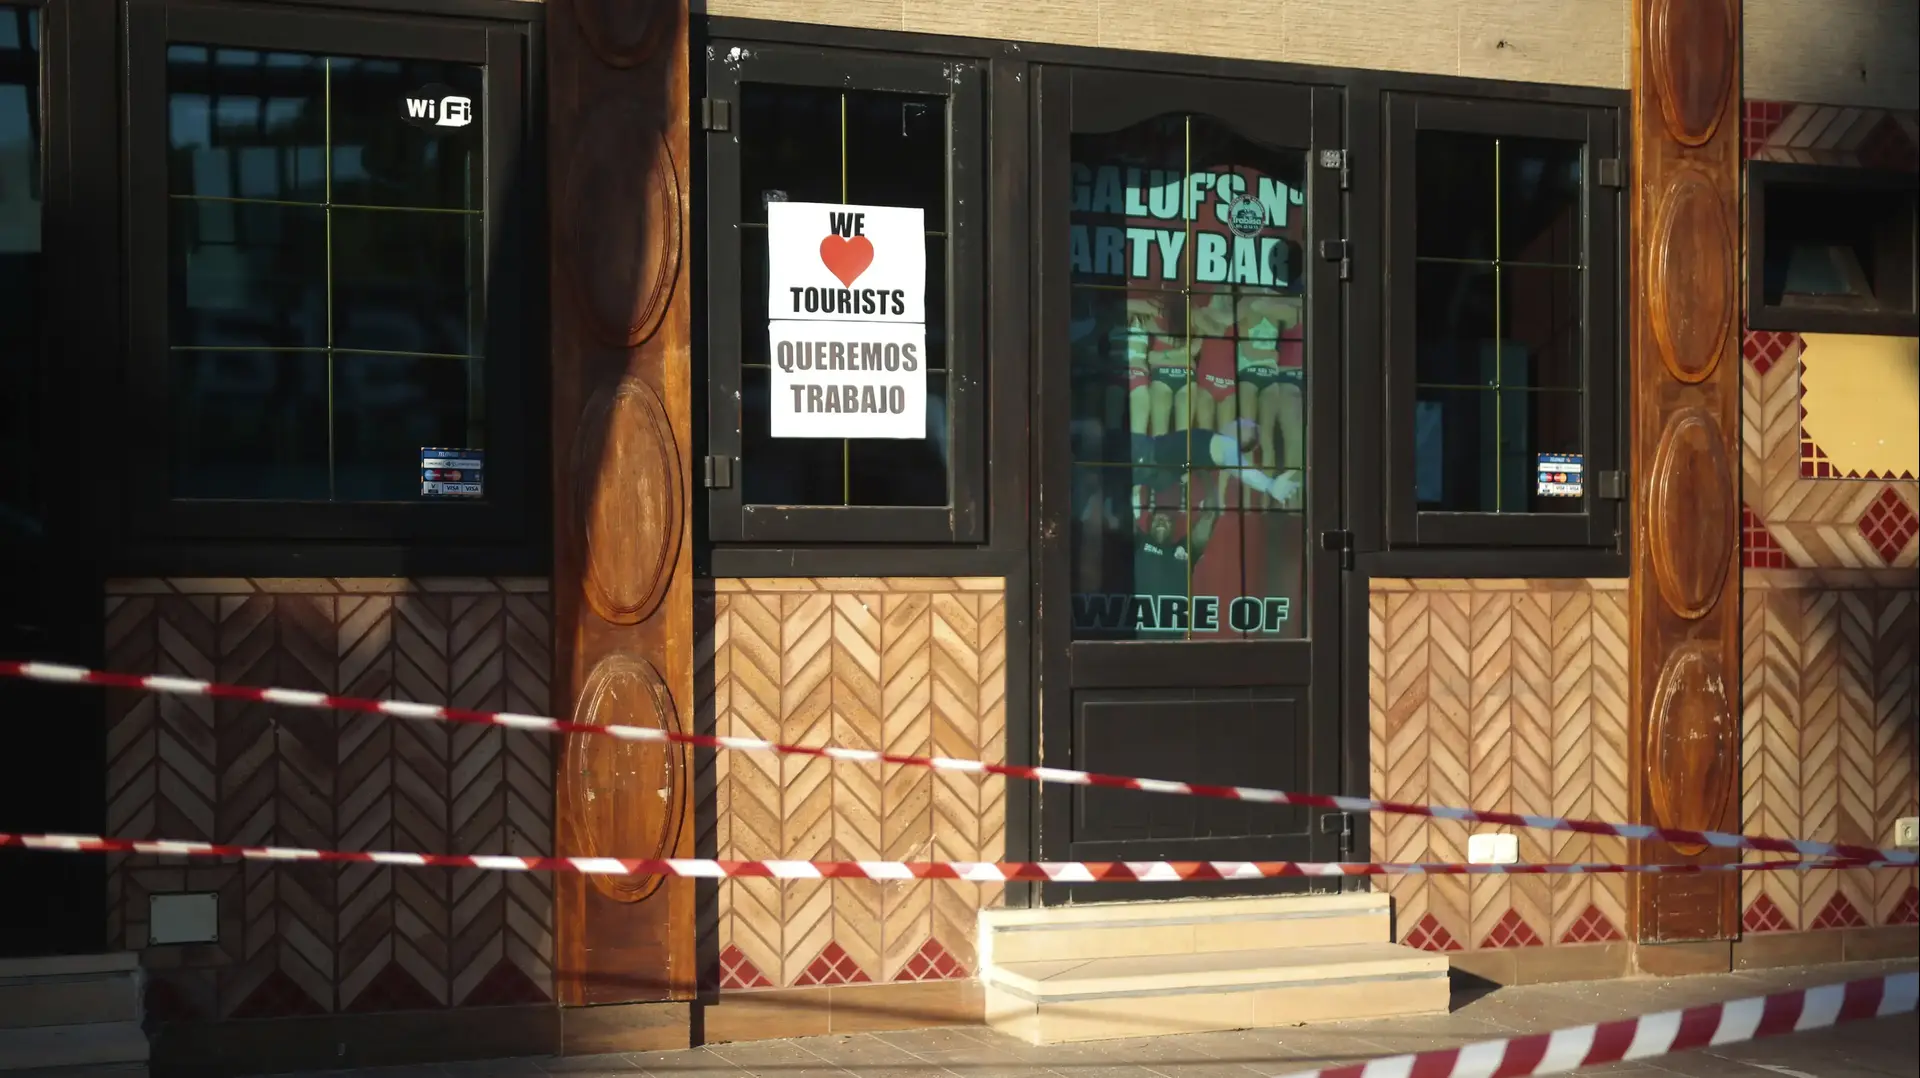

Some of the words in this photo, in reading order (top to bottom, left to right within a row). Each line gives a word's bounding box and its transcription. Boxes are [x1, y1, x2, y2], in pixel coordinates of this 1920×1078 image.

[829, 211, 865, 238] WE
[1196, 232, 1289, 287] BAR
[790, 286, 905, 315] TOURISTS
[777, 340, 918, 373] QUEREMOS
[790, 384, 906, 415] TRABAJO
[1070, 594, 1219, 632] WARE
[1229, 596, 1290, 632] OF
